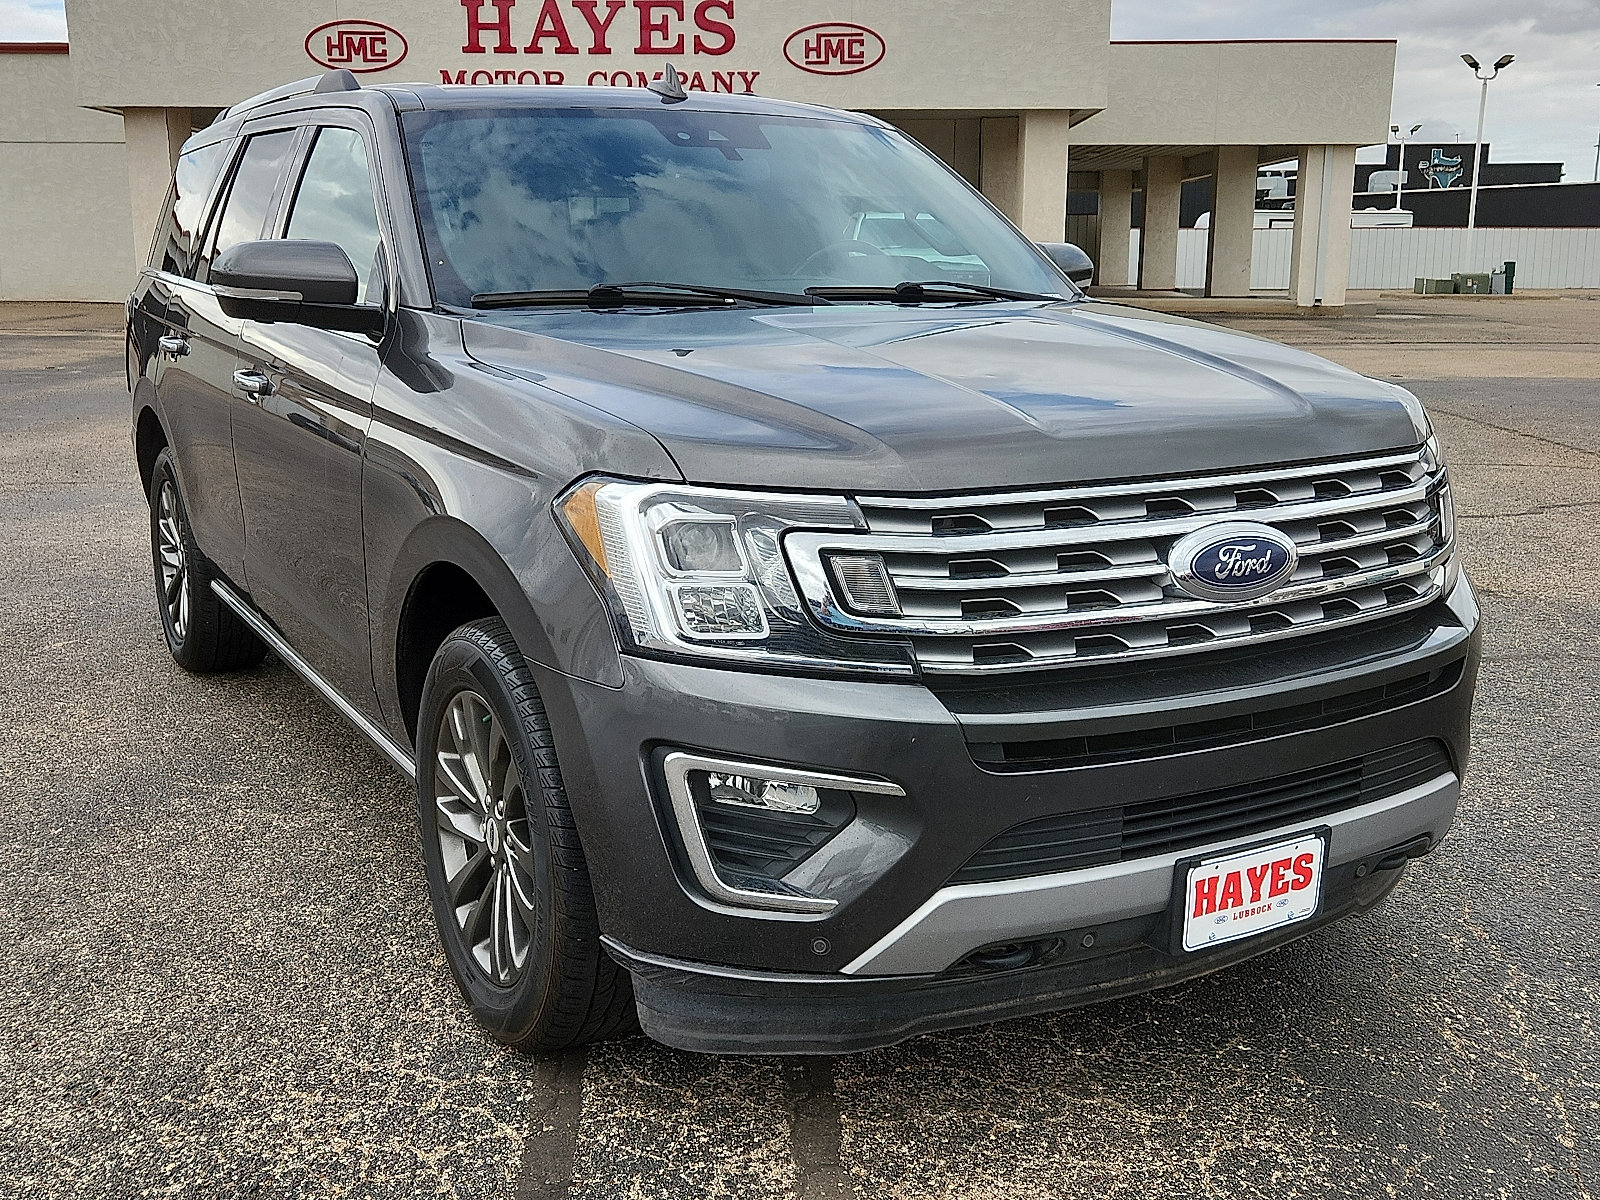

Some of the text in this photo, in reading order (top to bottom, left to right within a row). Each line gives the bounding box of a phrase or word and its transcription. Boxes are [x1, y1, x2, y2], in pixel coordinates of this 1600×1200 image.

[461, 0, 736, 55] HAYES
[326, 31, 388, 63] HMC
[804, 33, 864, 64] HMC
[439, 69, 566, 86] MOTOR
[1214, 544, 1272, 580] Ford
[1193, 853, 1314, 918] HAYES
[1232, 903, 1273, 921] LUBBOCK
